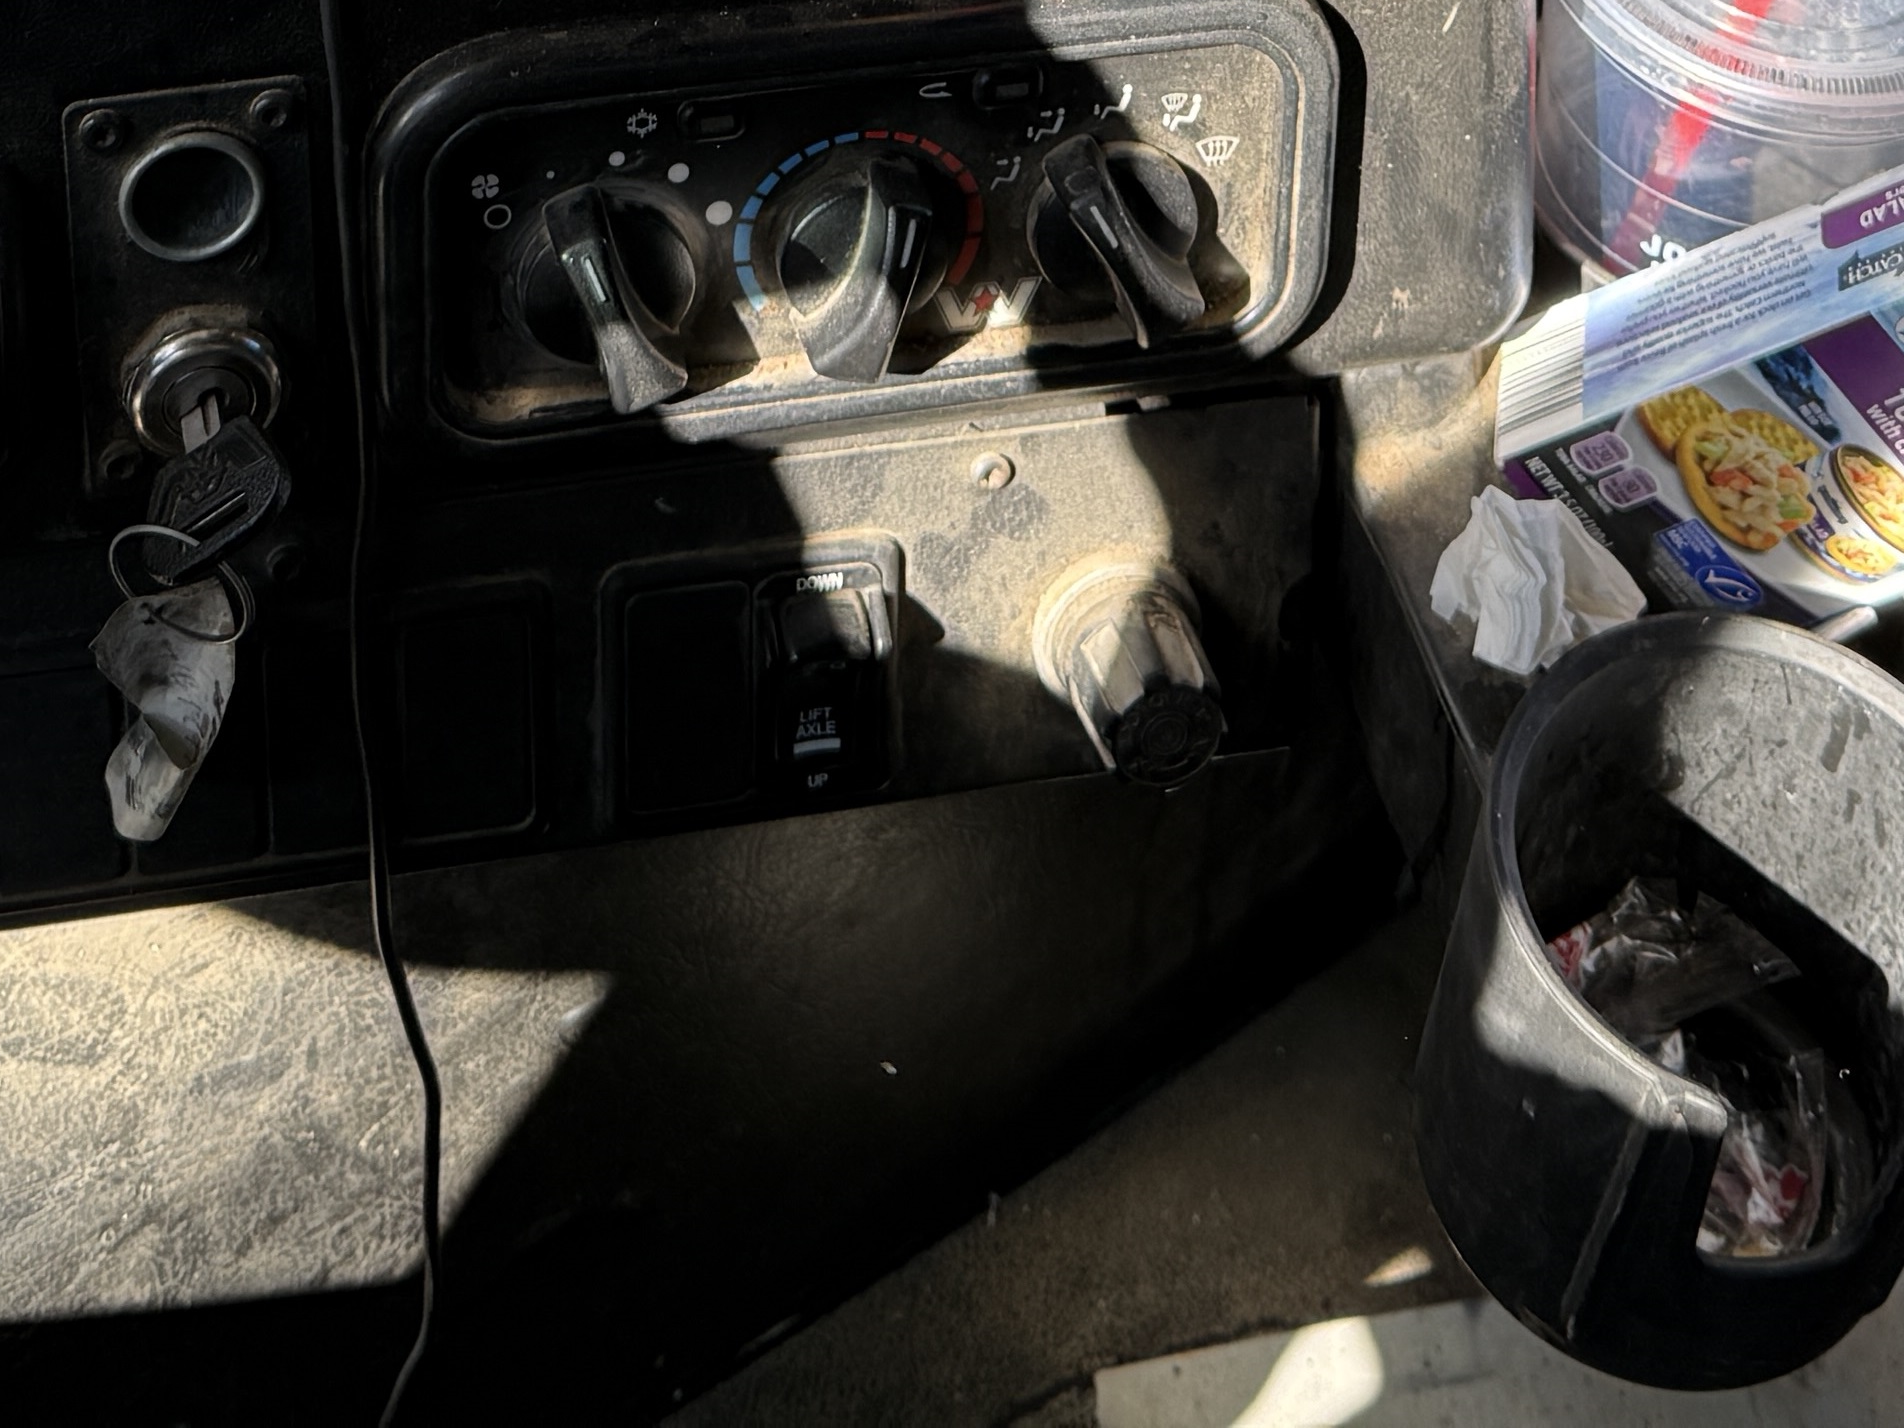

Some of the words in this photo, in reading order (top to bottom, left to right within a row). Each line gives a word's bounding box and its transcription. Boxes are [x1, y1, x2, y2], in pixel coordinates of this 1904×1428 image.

[1846, 250, 1904, 284] CATCH
[1866, 403, 1904, 439] with
[1523, 455, 1552, 479] NET
[796, 572, 843, 592] DOWN
[799, 707, 833, 723] LIFT
[796, 720, 837, 739] AXLE
[807, 772, 829, 789] UP
